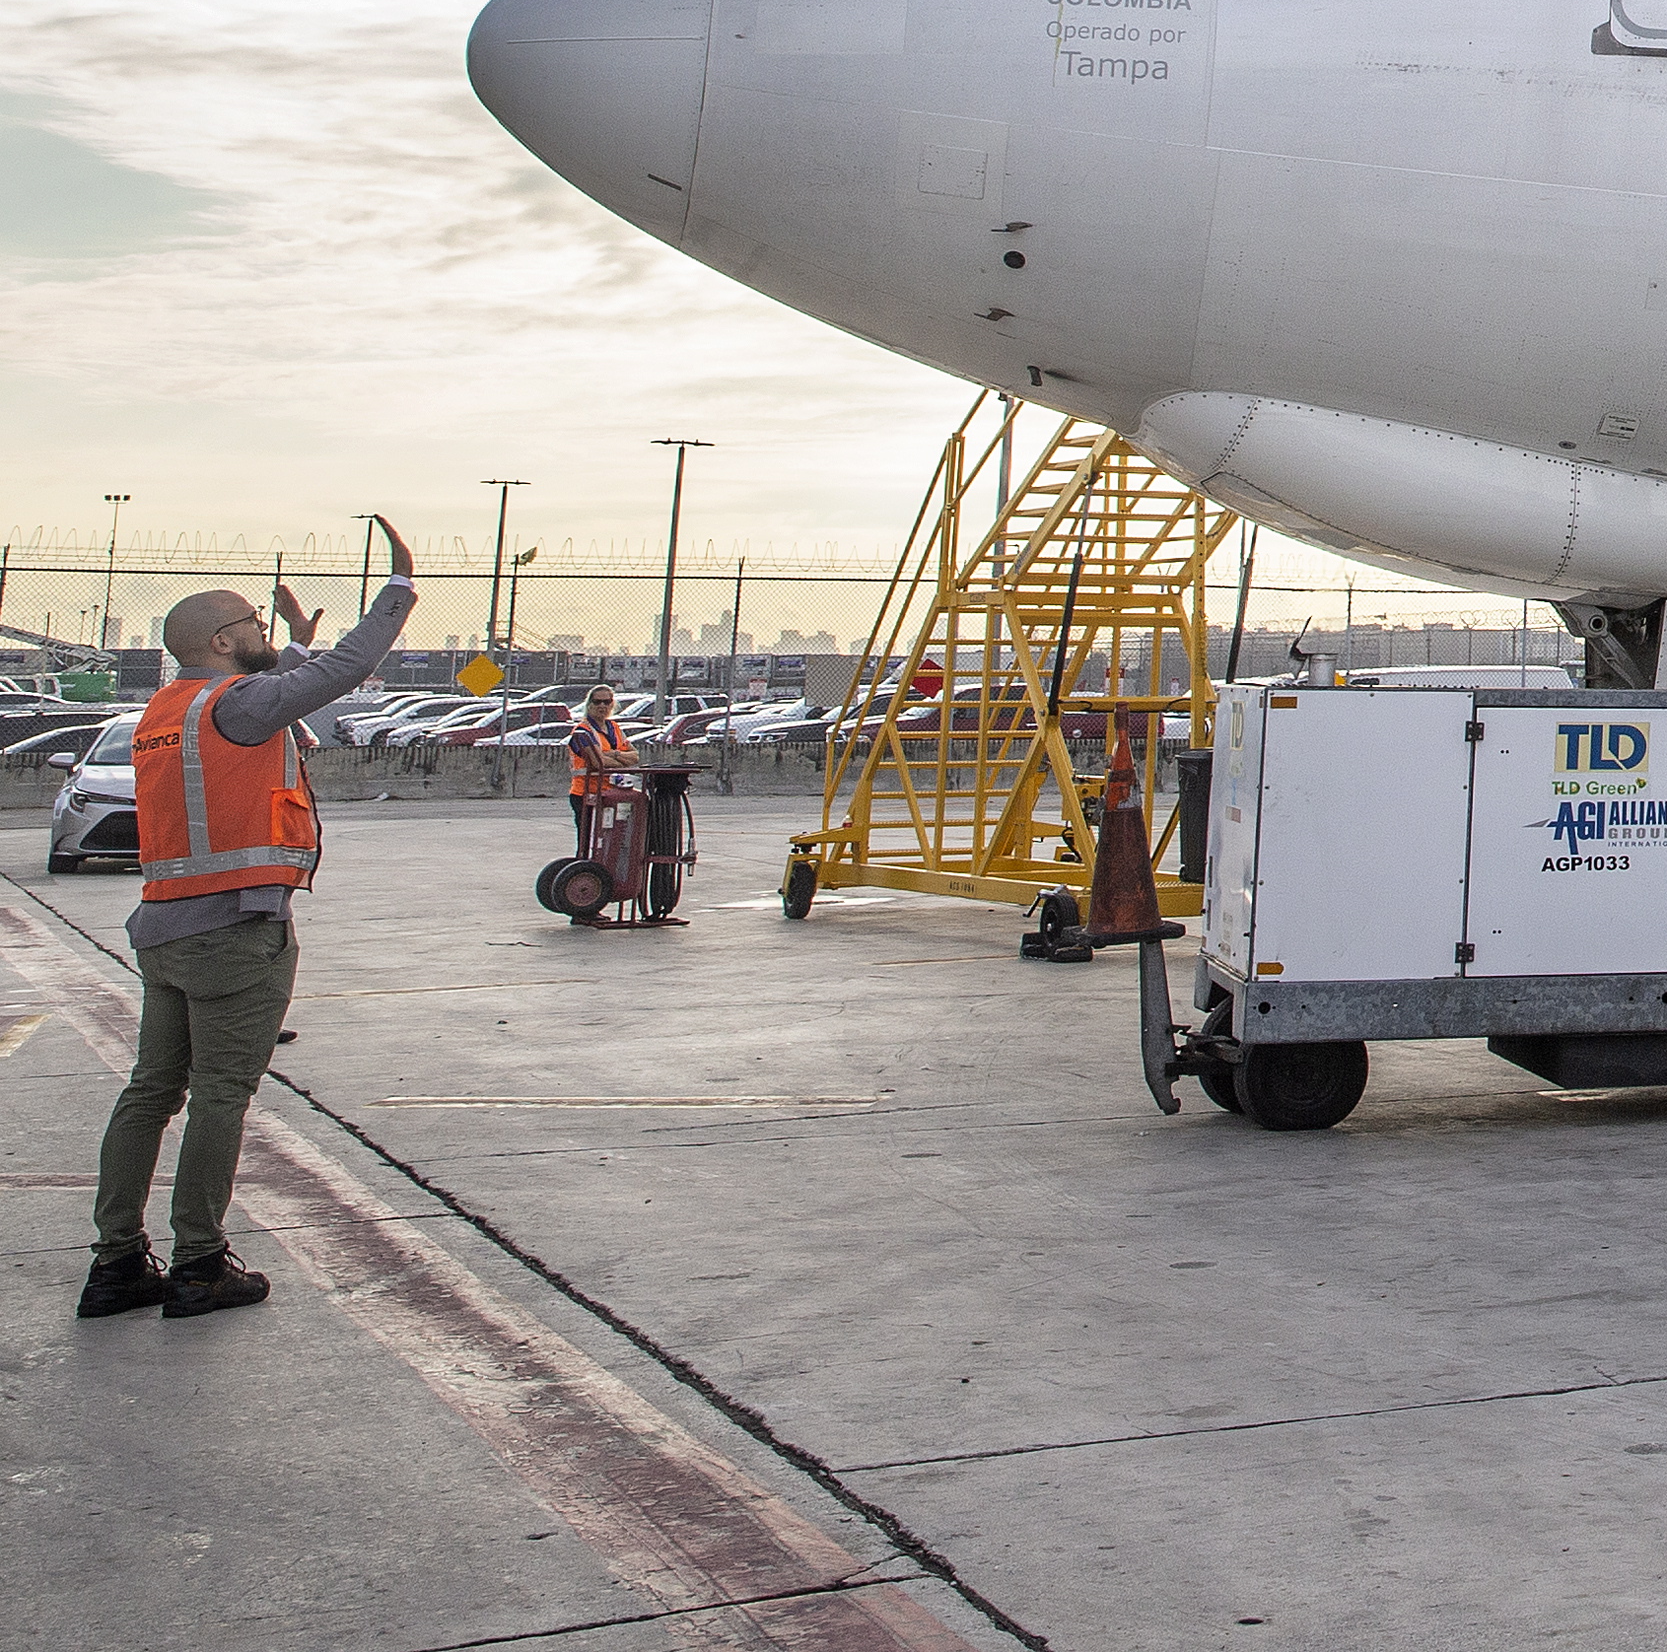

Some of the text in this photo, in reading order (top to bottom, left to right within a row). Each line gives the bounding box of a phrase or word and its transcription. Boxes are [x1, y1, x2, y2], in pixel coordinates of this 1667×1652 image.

[1046, 20, 1187, 46] Operado por
[1060, 50, 1169, 85] Tampa
[1558, 724, 1647, 771] TLD
[1552, 781, 1637, 795] TLD Green
[1546, 801, 1606, 855] AGI
[1541, 856, 1630, 872] AGP1033
